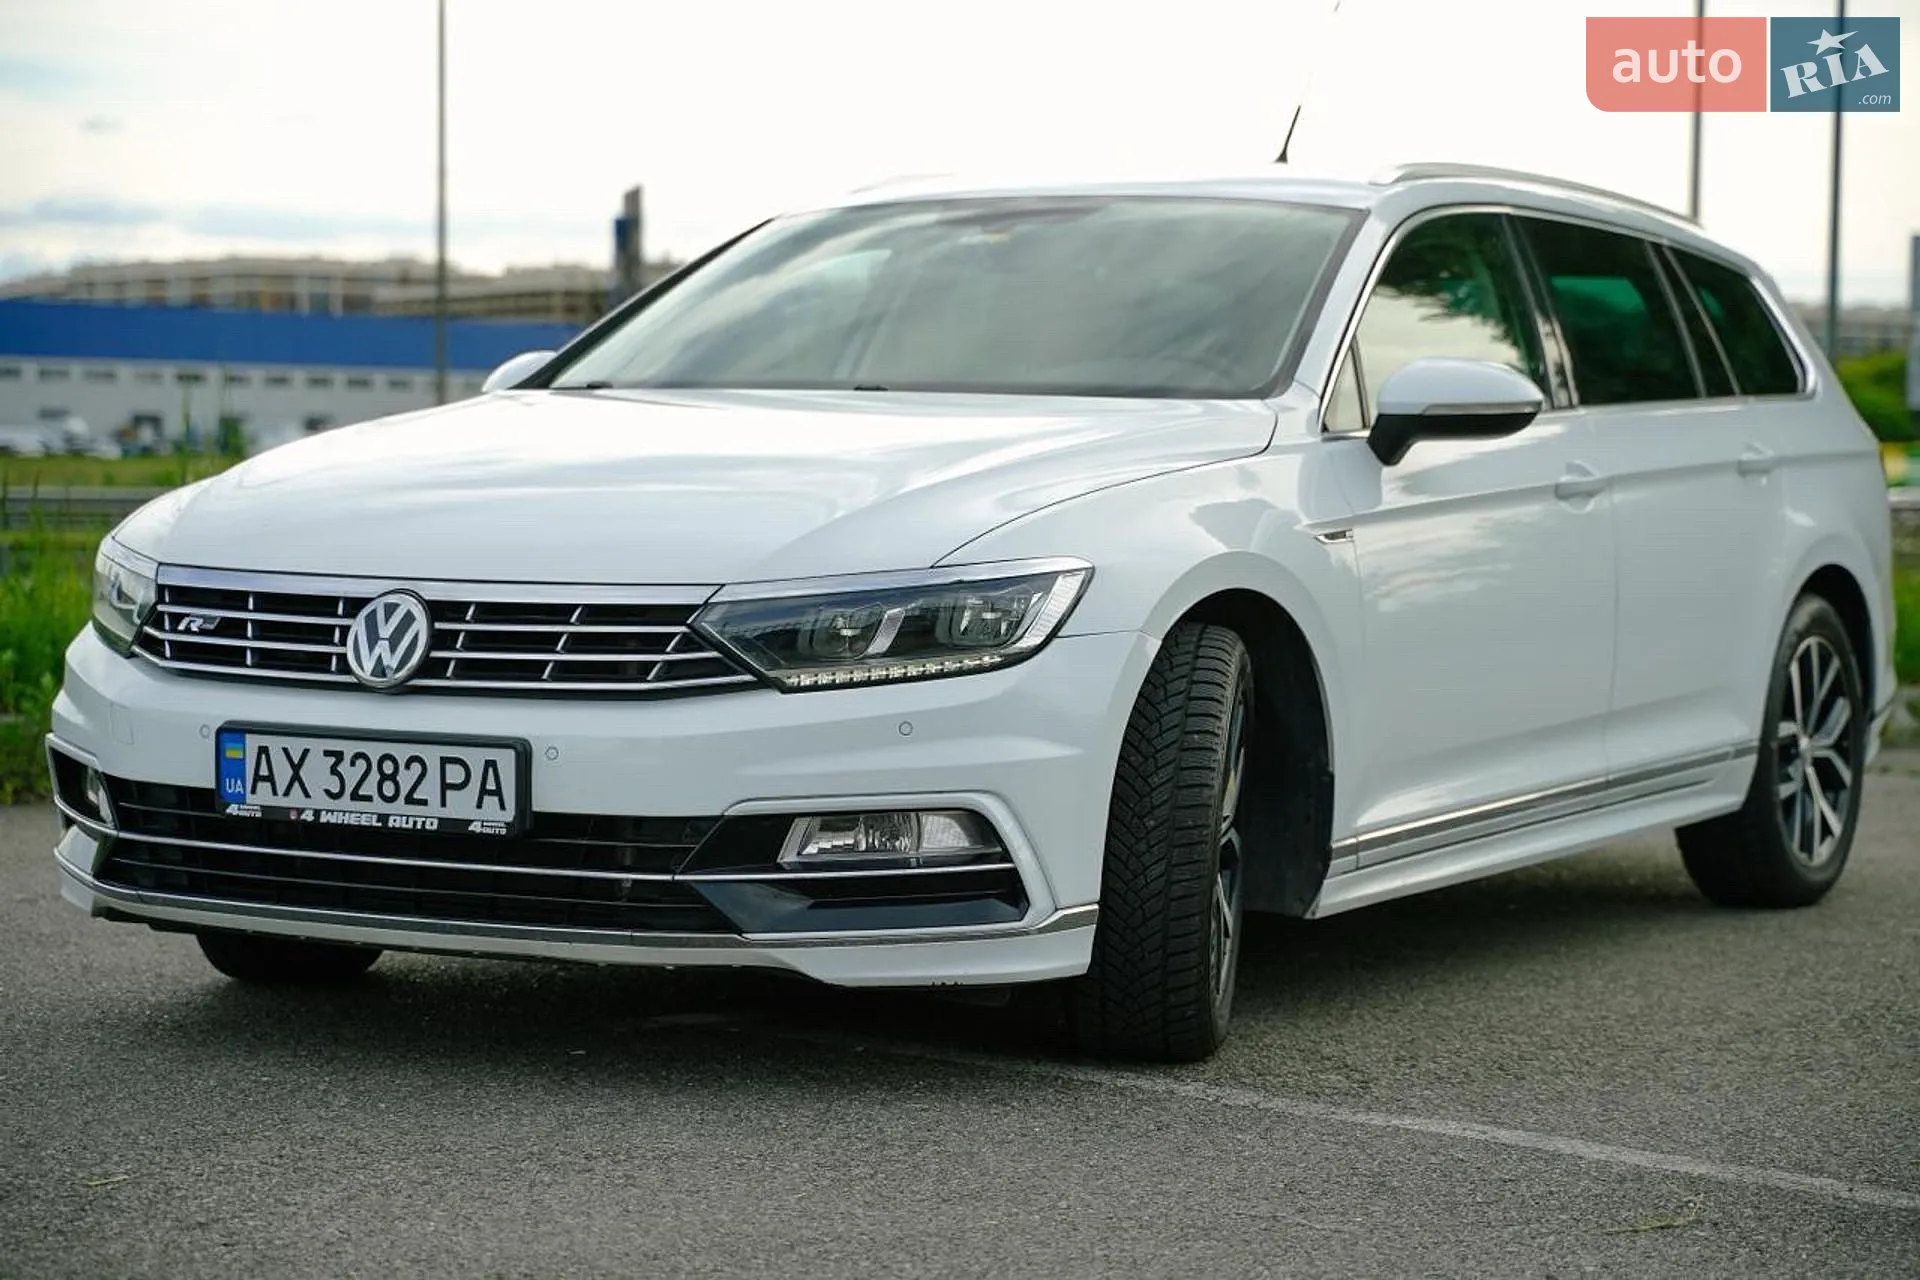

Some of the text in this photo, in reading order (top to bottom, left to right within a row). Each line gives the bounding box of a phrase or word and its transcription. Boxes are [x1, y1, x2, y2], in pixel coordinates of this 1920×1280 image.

[225, 778, 245, 795] UA
[250, 745, 507, 812] AX 3282 PA
[300, 809, 439, 831] 4 WHEEL AUTO
